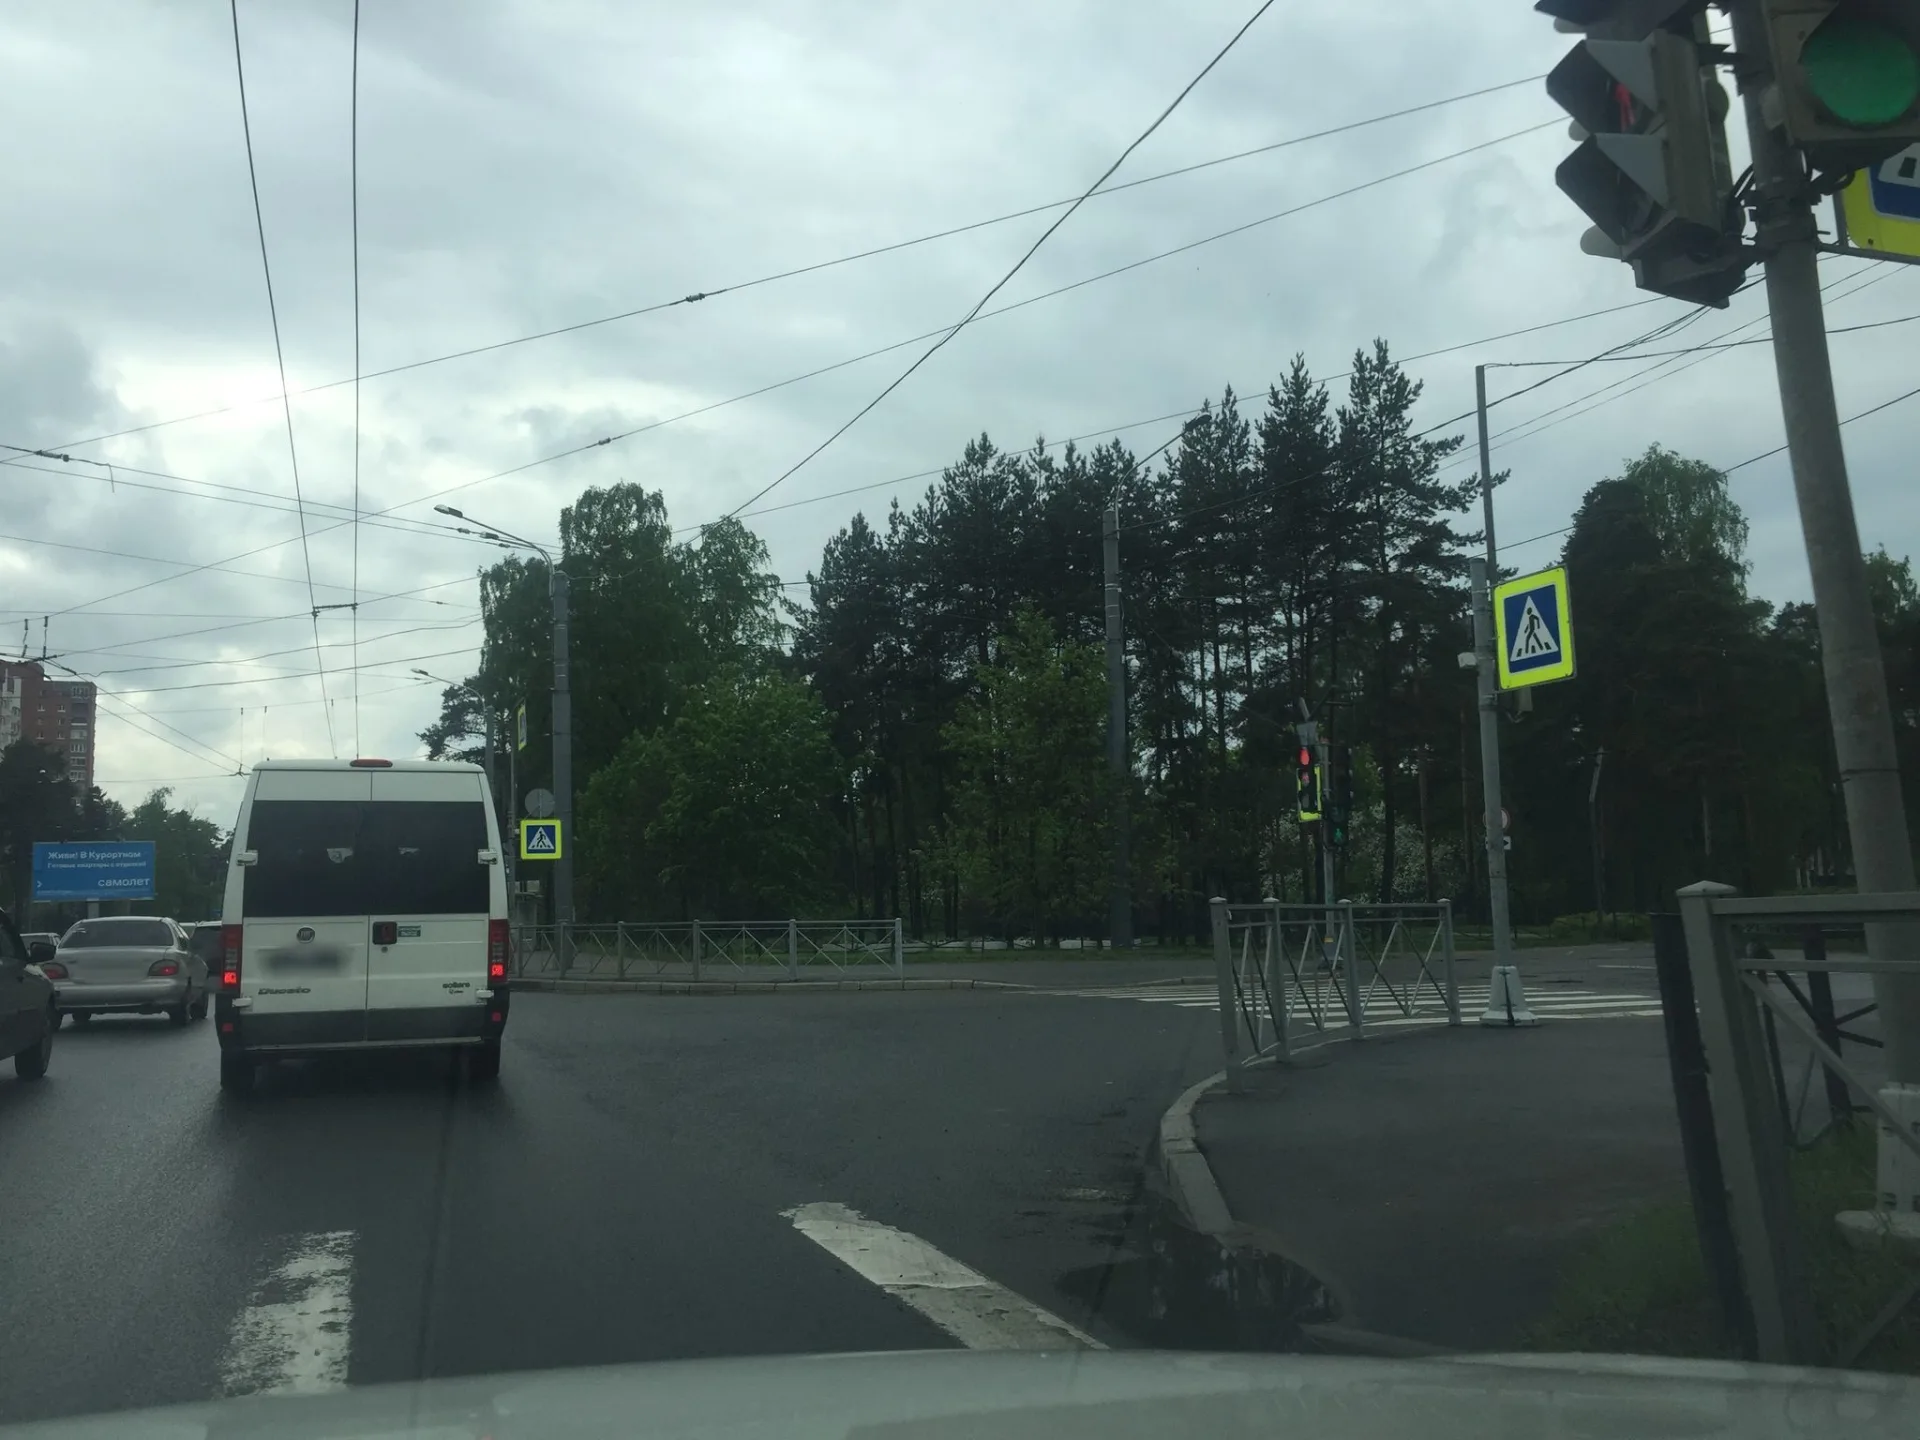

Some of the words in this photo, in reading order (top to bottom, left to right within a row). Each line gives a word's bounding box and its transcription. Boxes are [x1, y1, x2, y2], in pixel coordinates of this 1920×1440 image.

[48, 851, 78, 860] Живи!
[80, 851, 88, 859] В
[89, 851, 141, 861] Курортном
[98, 878, 150, 887] самолет
